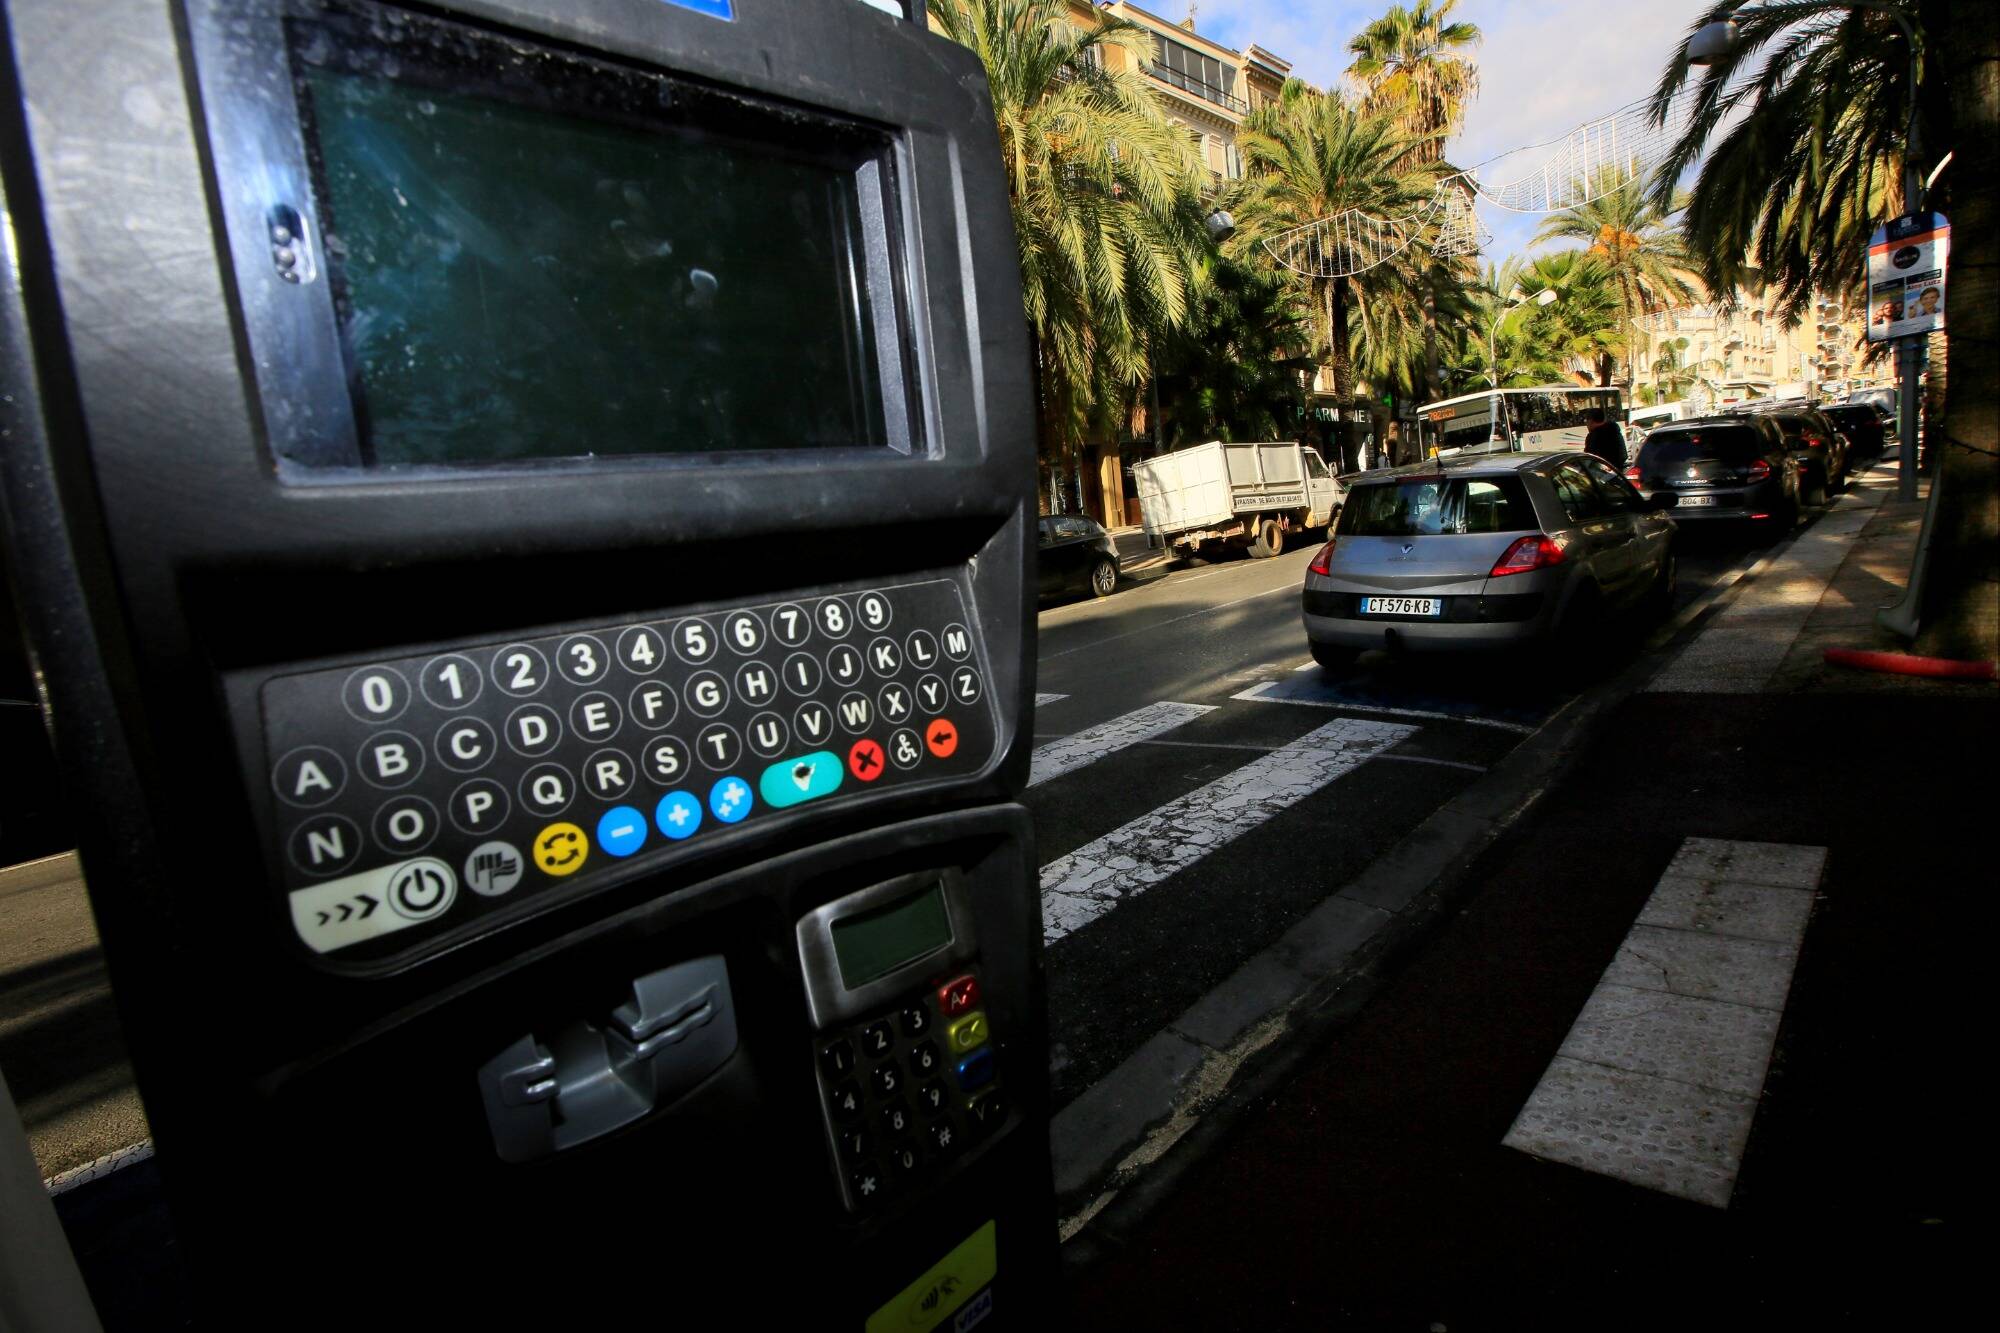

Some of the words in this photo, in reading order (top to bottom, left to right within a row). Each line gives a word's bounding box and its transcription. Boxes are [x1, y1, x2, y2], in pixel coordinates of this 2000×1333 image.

[1369, 599, 1431, 613] CT-576-KB
[361, 674, 394, 714] 0
[438, 663, 464, 700] 1
[505, 652, 537, 690] 2
[570, 642, 598, 677] 3
[630, 633, 655, 666] 4
[684, 624, 708, 657] 5
[734, 617, 757, 648] 6
[779, 610, 798, 640] 7
[824, 603, 845, 632] 8
[865, 597, 884, 625] 9
[296, 760, 331, 795] A
[374, 743, 409, 777] B
[451, 728, 482, 760] C
[518, 715, 548, 747] D
[583, 701, 611, 733] E
[642, 690, 663, 720] F
[695, 680, 721, 707] G
[745, 669, 769, 698] H
[797, 662, 808, 686] I
[838, 652, 853, 678] J
[875, 644, 896, 670] K
[914, 639, 932, 661] L
[946, 630, 967, 654] M
[309, 827, 343, 863] N
[389, 809, 424, 841] O
[466, 791, 493, 823] P
[532, 775, 565, 805] Q
[595, 760, 625, 790] R
[655, 746, 679, 775] S
[707, 732, 728, 760] T
[756, 721, 779, 748] U
[801, 710, 821, 736] V
[841, 699, 867, 726] W
[885, 690, 906, 716] X
[922, 682, 938, 705] Y
[958, 673, 976, 697] Z
[835, 1051, 843, 1069] 1
[873, 1030, 887, 1049] 2
[912, 1010, 923, 1028] 3
[843, 1091, 855, 1110] 4
[884, 1072, 895, 1090] 5
[921, 1050, 932, 1068] 6
[958, 1028, 972, 1046] C
[853, 1134, 862, 1153] 7
[893, 1110, 904, 1130] 8
[930, 1089, 940, 1107] 9
